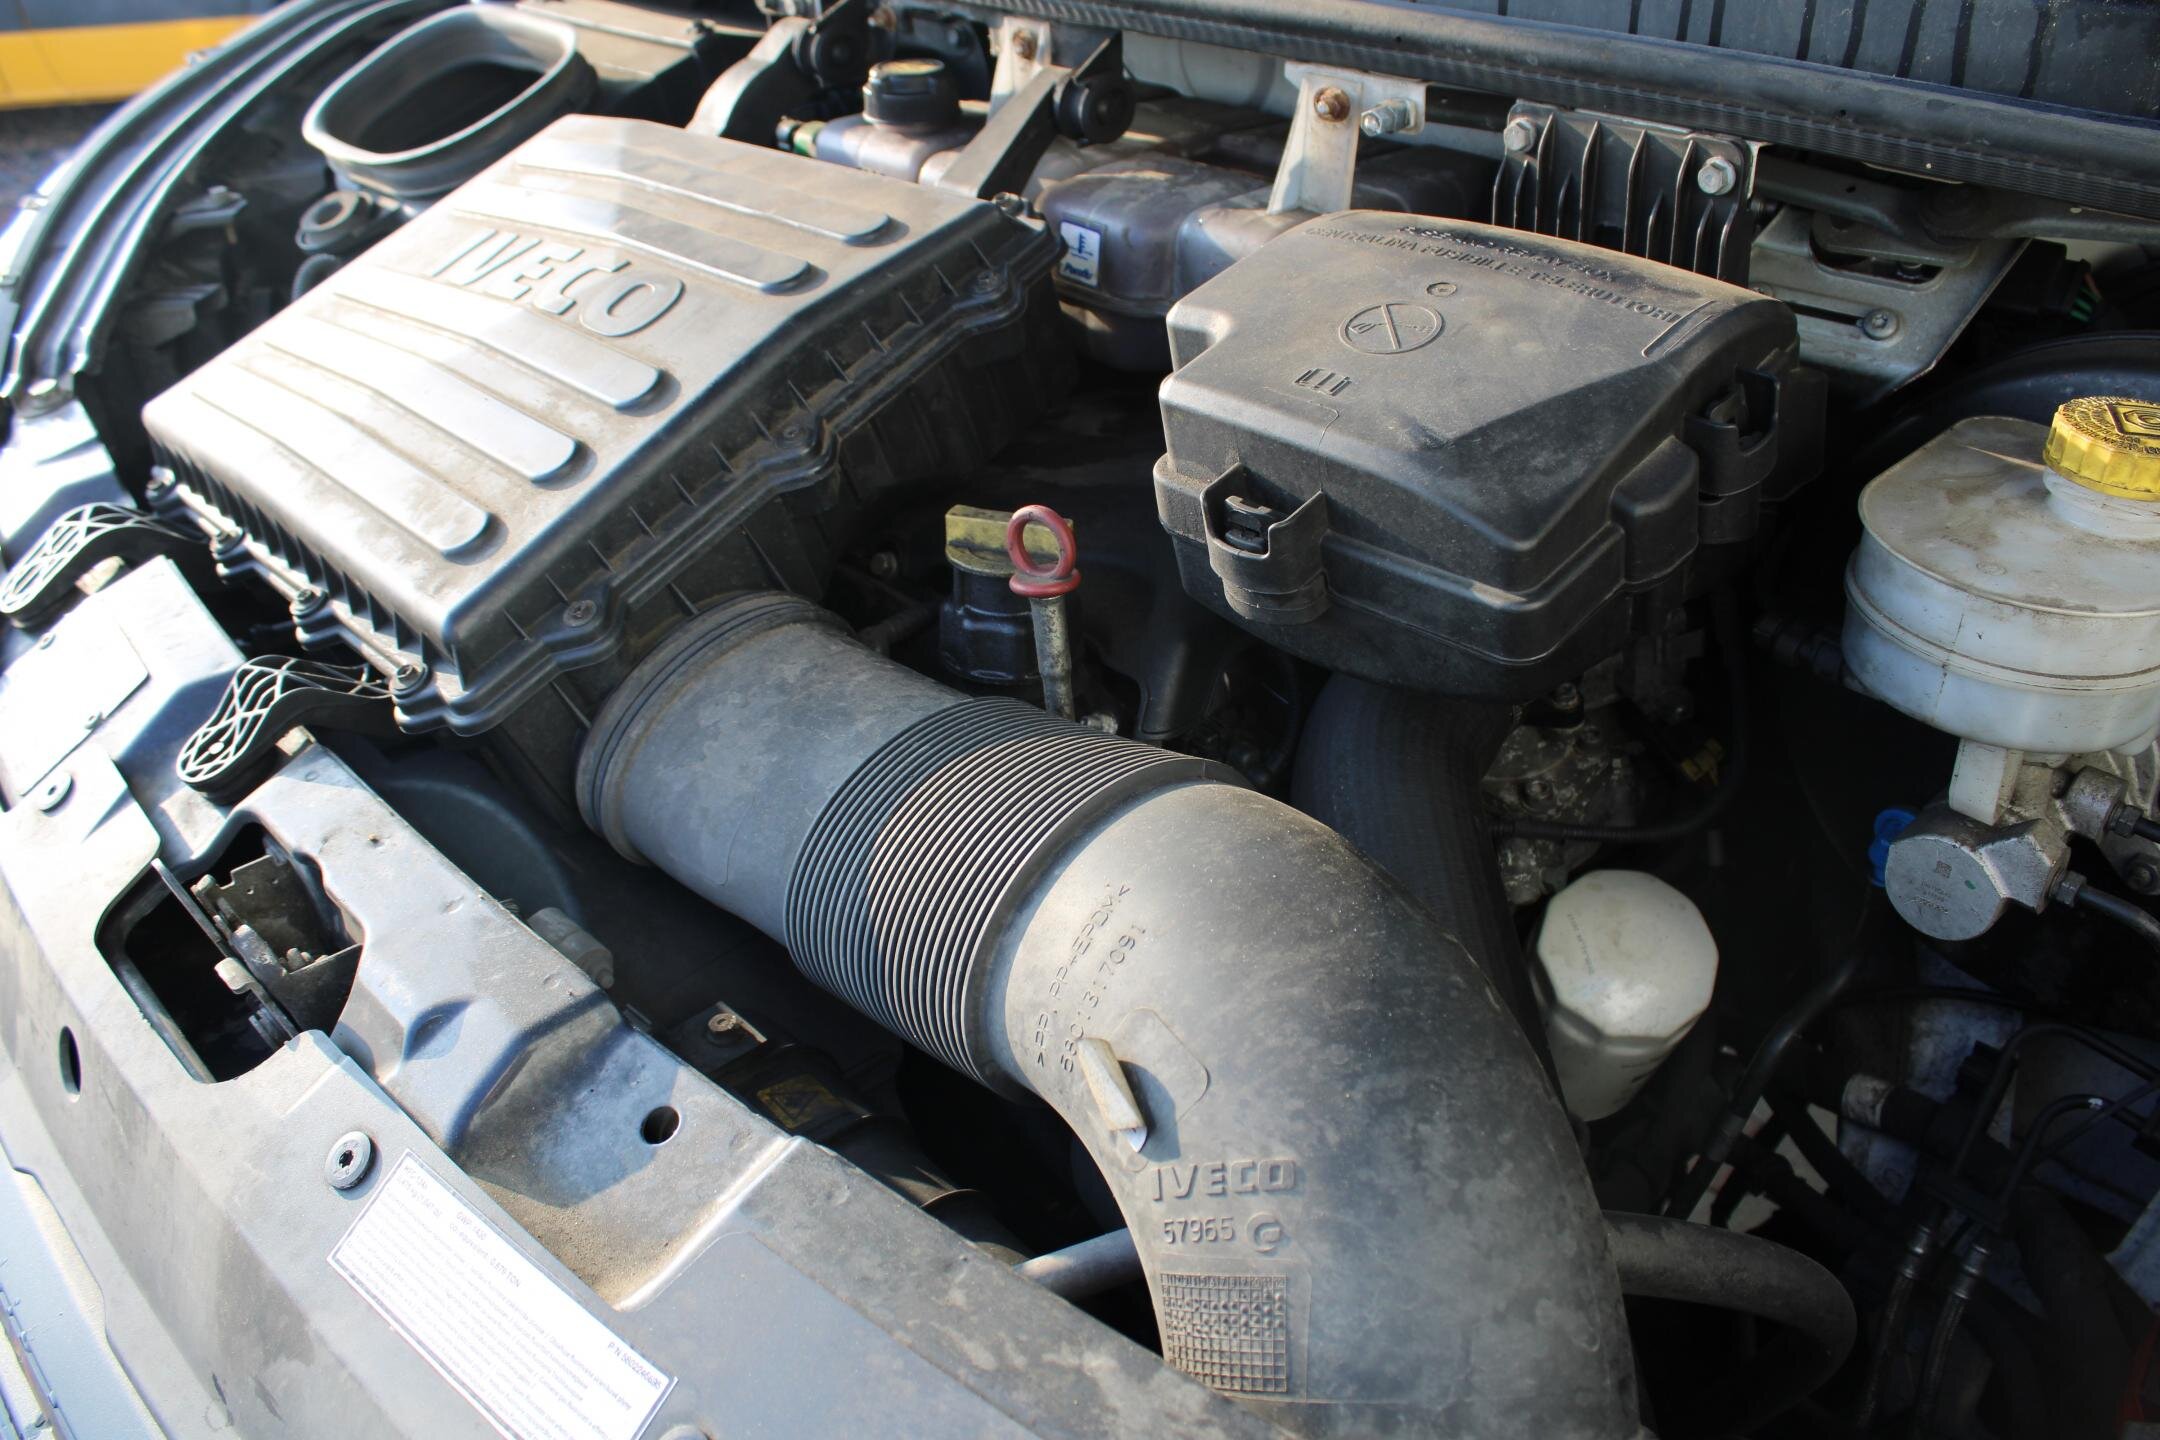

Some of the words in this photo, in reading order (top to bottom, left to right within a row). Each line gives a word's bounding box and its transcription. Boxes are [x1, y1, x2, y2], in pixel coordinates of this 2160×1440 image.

[430, 228, 686, 338] IVECO
[1150, 1158, 1297, 1202] IVECO
[1162, 1216, 1235, 1244] 57965
